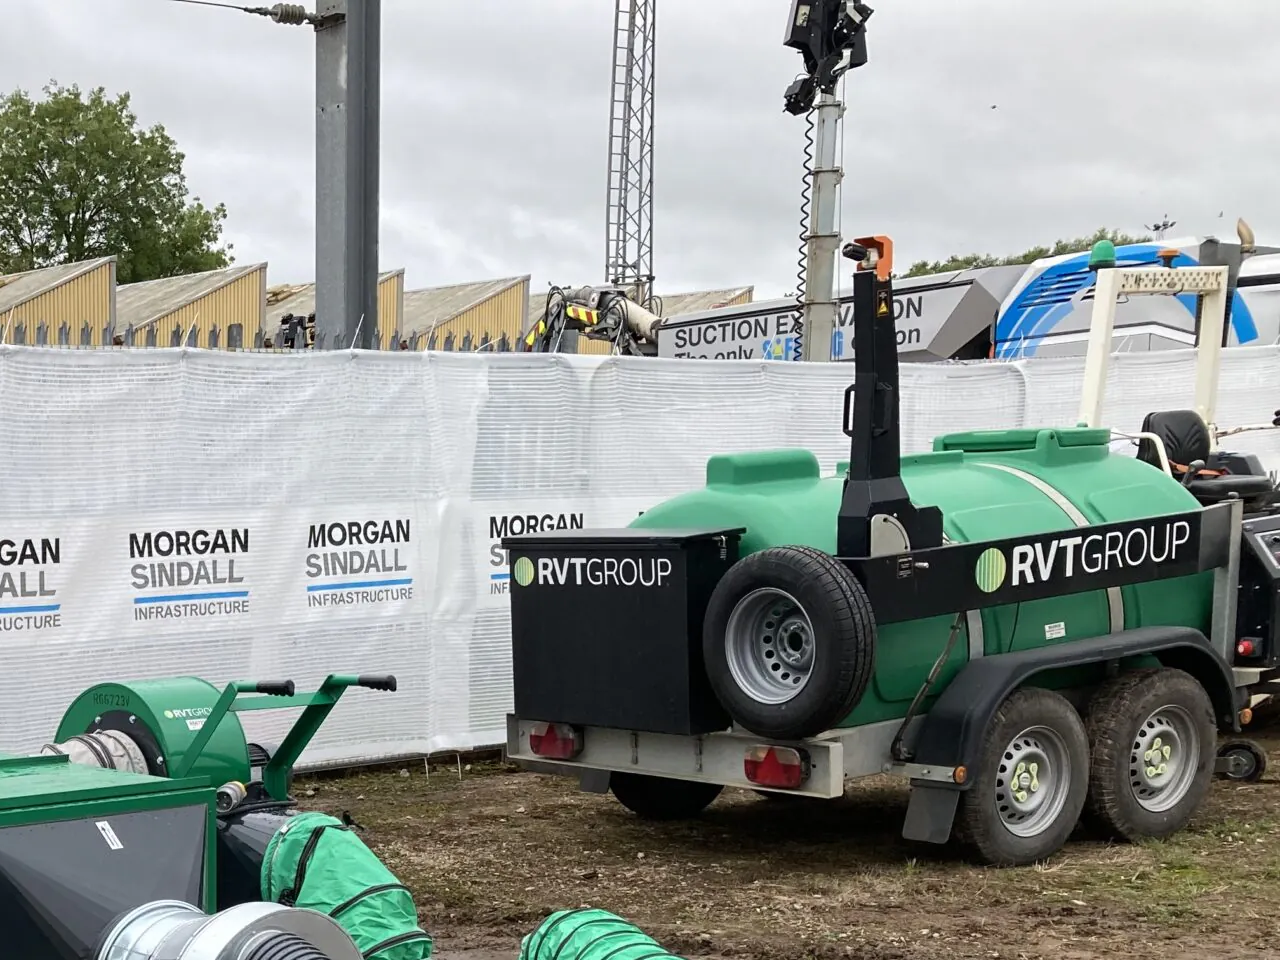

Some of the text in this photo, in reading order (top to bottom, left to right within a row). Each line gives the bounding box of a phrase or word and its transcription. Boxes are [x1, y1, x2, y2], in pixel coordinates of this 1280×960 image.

[674, 317, 768, 349] SUCTION
[308, 518, 410, 549] MORGAN
[489, 513, 584, 539] MORGAN
[129, 528, 249, 558] MORGAN
[1011, 520, 1190, 586] RVTGROUP
[130, 559, 244, 589] SINDALL
[305, 548, 407, 578] SINDALL
[537, 557, 672, 587] RVTGROUP
[134, 600, 249, 621] INFRASTRUCTURE
[307, 587, 413, 607] INFRASTRUCTURE
